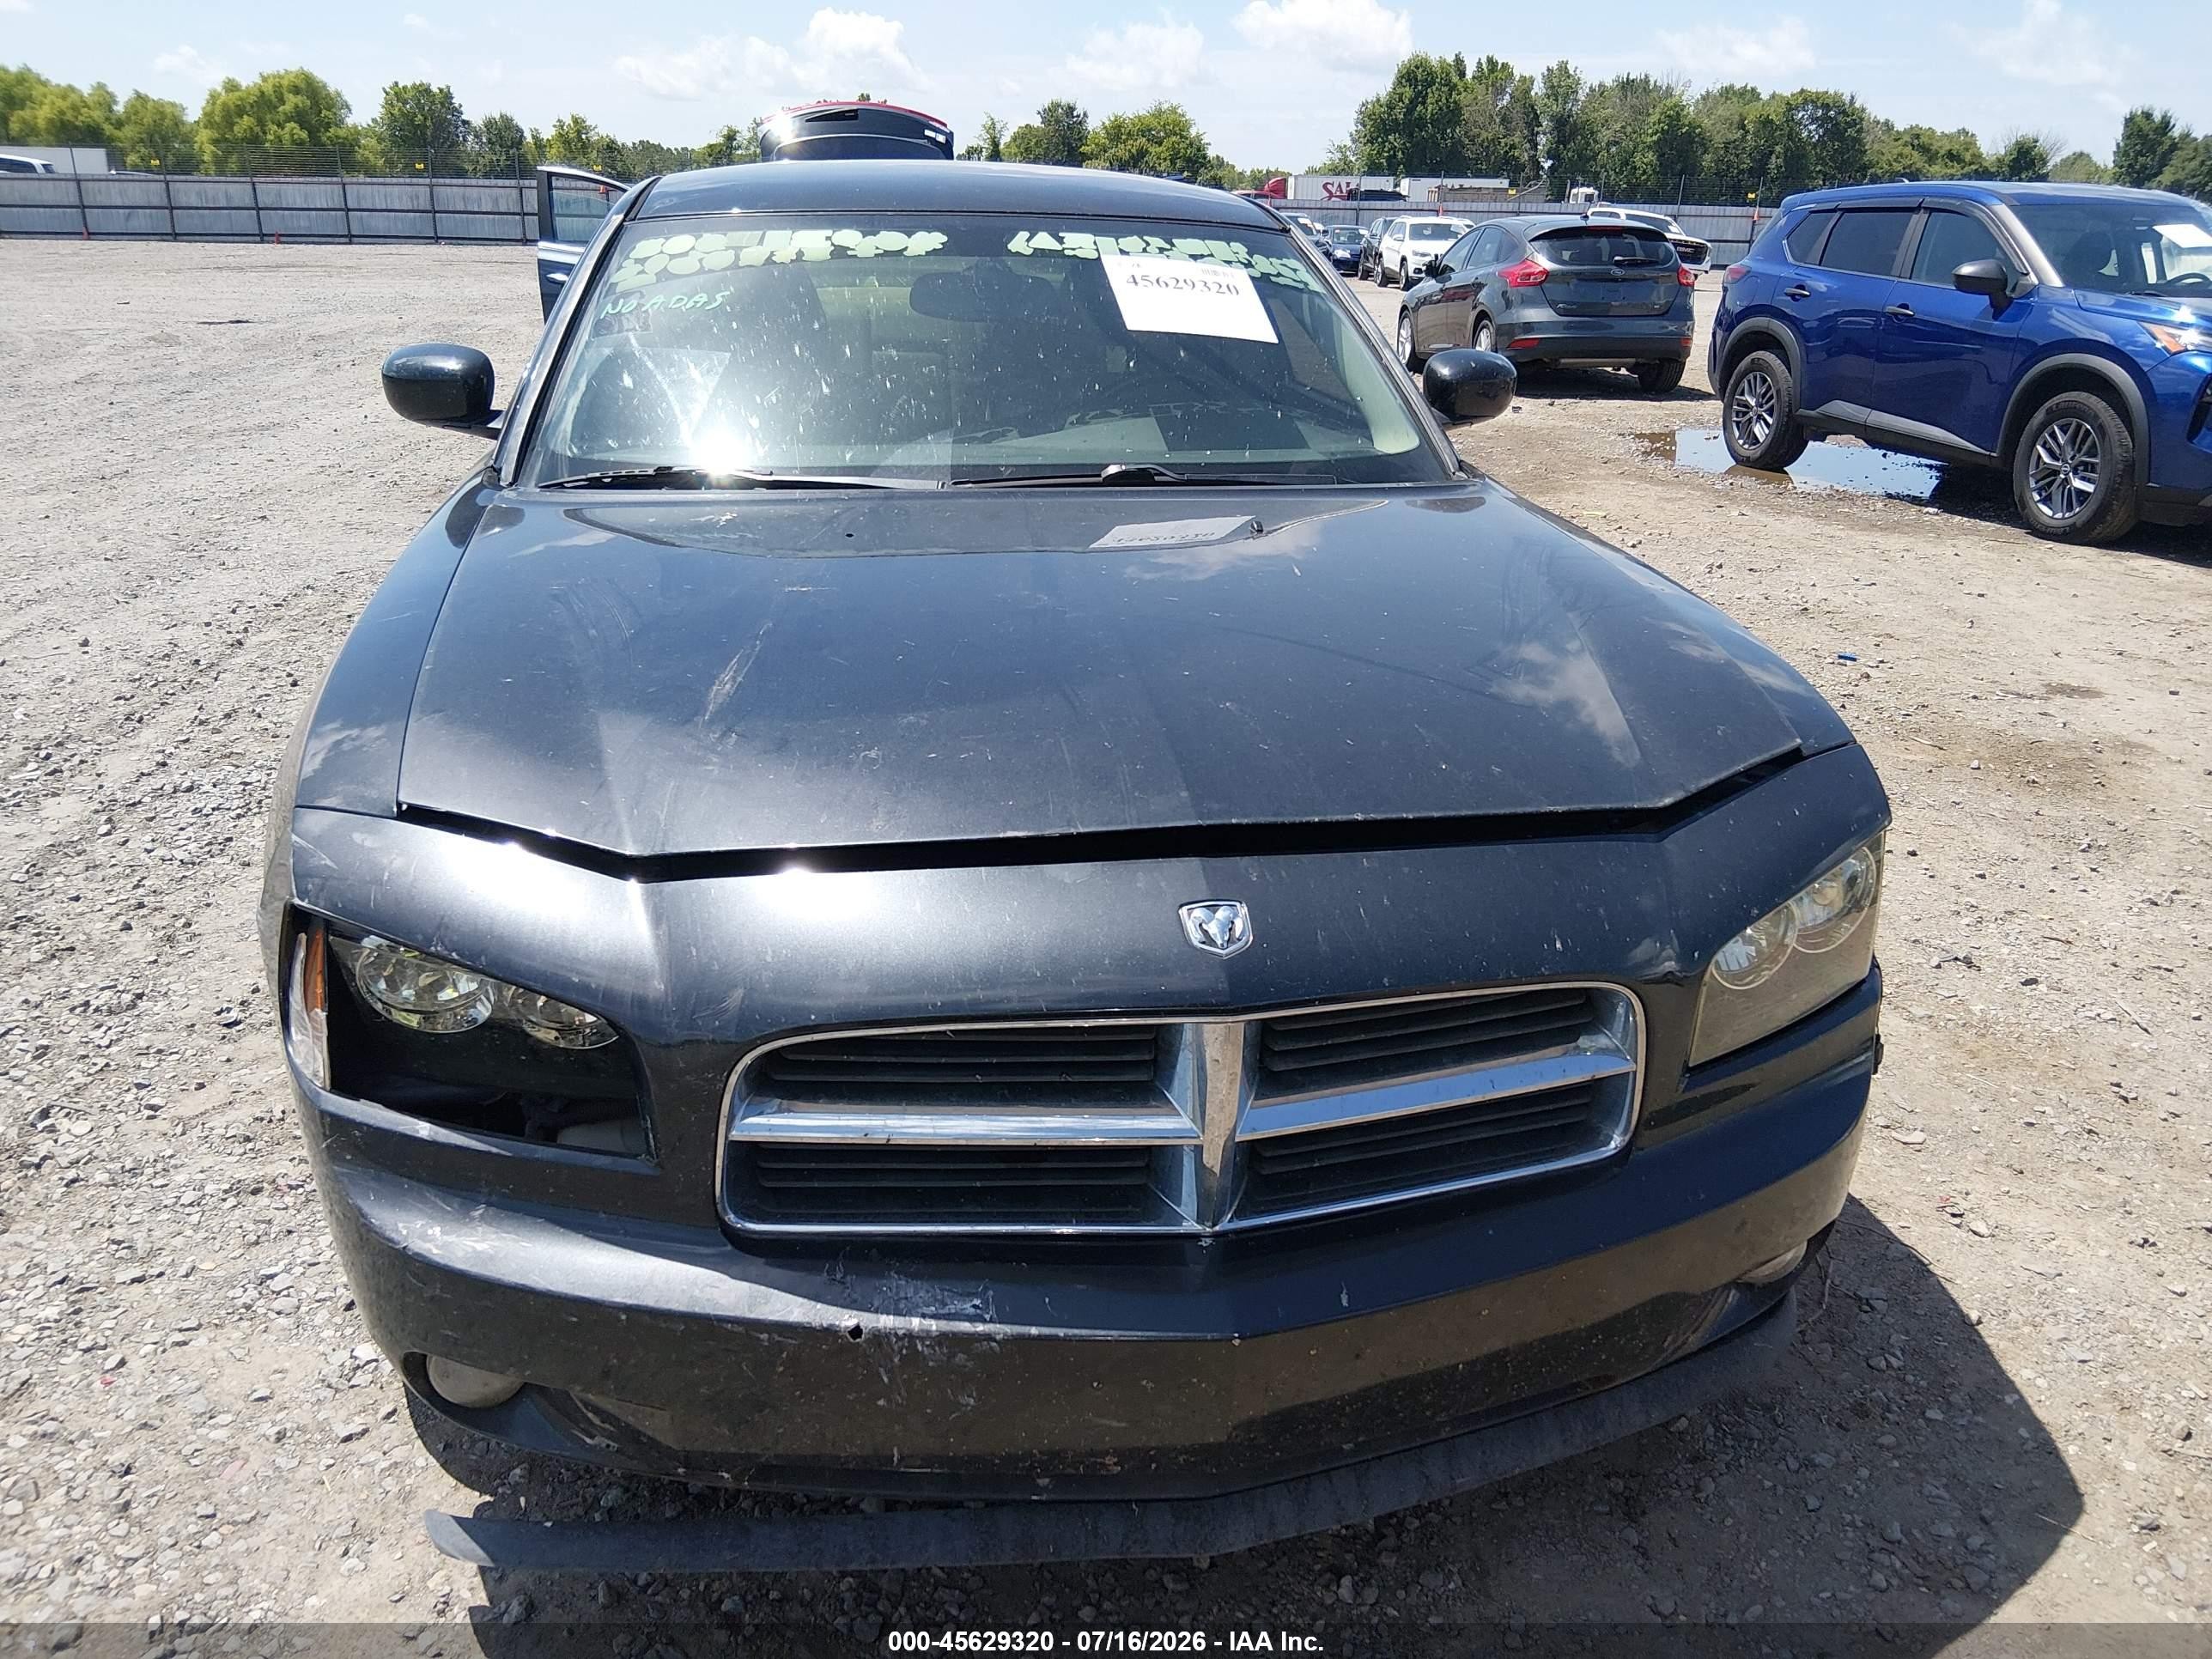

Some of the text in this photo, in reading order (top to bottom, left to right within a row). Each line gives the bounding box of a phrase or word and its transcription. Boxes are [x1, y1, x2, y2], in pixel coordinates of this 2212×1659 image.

[1126, 274, 1239, 295] 45629320
[600, 291, 731, 319] NO ADAS
